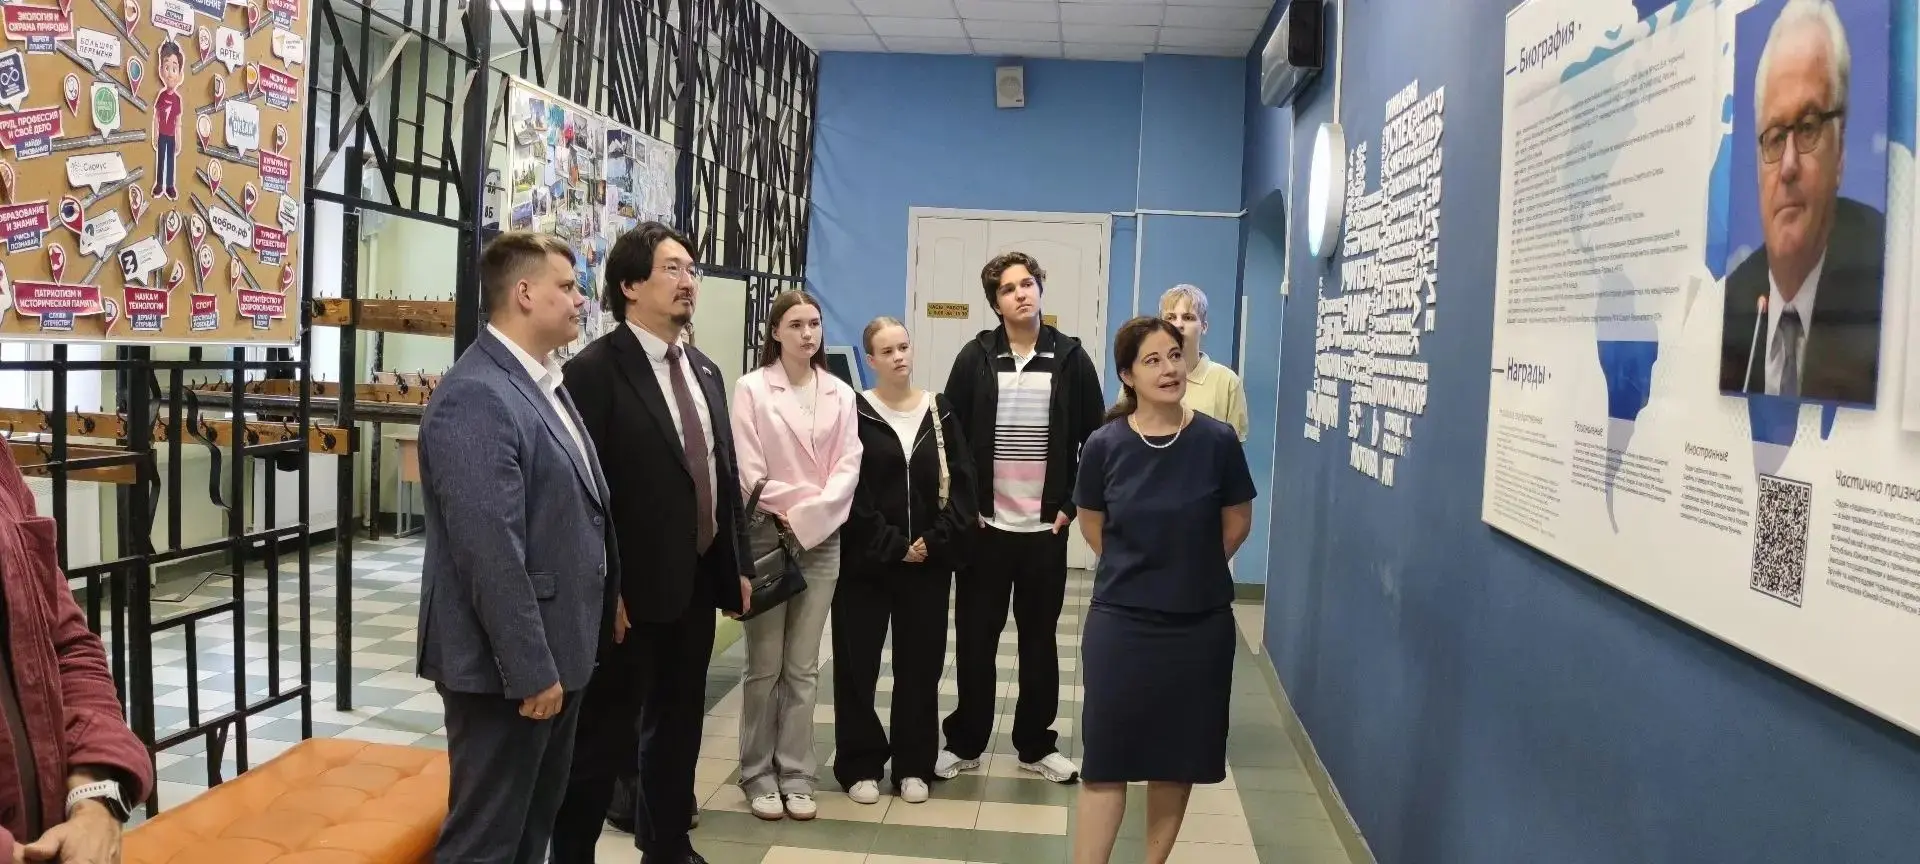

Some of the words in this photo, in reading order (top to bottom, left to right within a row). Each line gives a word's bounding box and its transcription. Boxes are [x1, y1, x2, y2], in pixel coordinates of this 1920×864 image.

[17, 12, 53, 21] ЭКОЛОГИЯ
[54, 13, 59, 21] И
[9, 22, 36, 31] ОХРАНА
[37, 22, 69, 32] ПРИРОДЫ
[1519, 20, 1575, 73] Биография
[219, 47, 240, 60] АРТЕК
[18, 111, 59, 126] ПРОФЕССИЯ
[34, 123, 52, 136] ДЕЛО
[0, 206, 45, 222] ОБРАЗОВАНИЕ
[6, 223, 12, 231] И
[13, 217, 39, 230] ЗНАНИЕ
[212, 216, 248, 239] добро.рф
[34, 289, 75, 298] ПАТРИОТИЗМ
[134, 292, 153, 301] НАУКА
[20, 299, 71, 308] ИСТОРИЧЕСКАЯ
[128, 301, 164, 310] ТЕХНОЛОГИИ
[195, 301, 213, 310] СПОРТ
[1507, 357, 1546, 390] Награды
[1835, 469, 1883, 494] Частично
